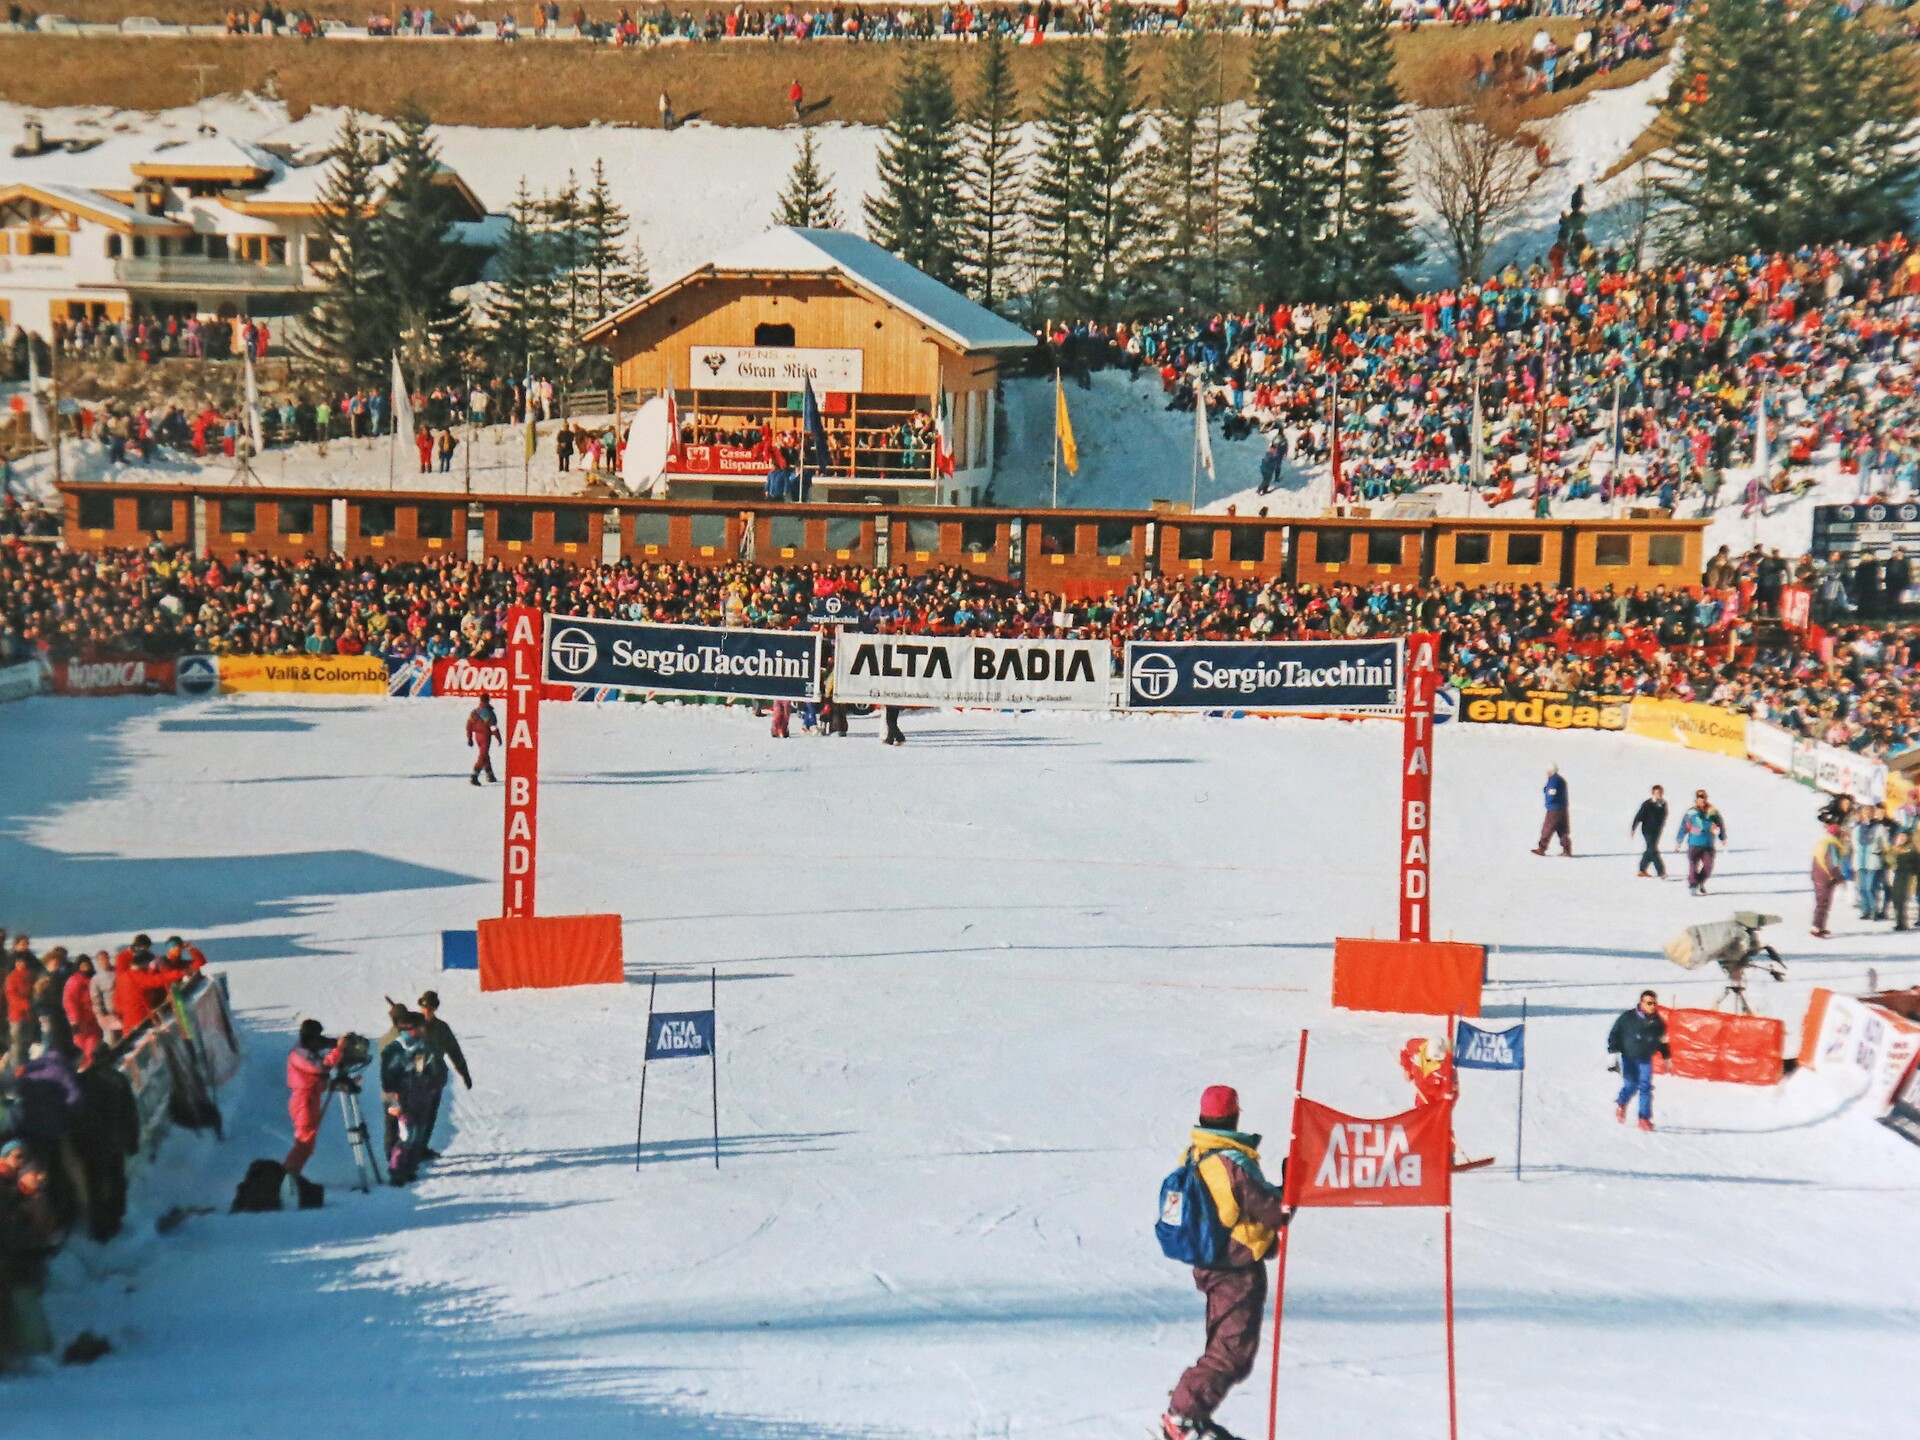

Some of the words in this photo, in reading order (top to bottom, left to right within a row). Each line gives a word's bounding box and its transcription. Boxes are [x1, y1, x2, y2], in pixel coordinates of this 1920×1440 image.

[737, 362, 776, 378] Gran
[719, 448, 752, 459] Cassa
[67, 658, 145, 688] NORDICA
[849, 643, 953, 680] ALTA
[973, 646, 1096, 682] BADIA
[1468, 698, 1624, 729] erdgas
[507, 776, 532, 917] BADI
[1405, 800, 1428, 942] BADI
